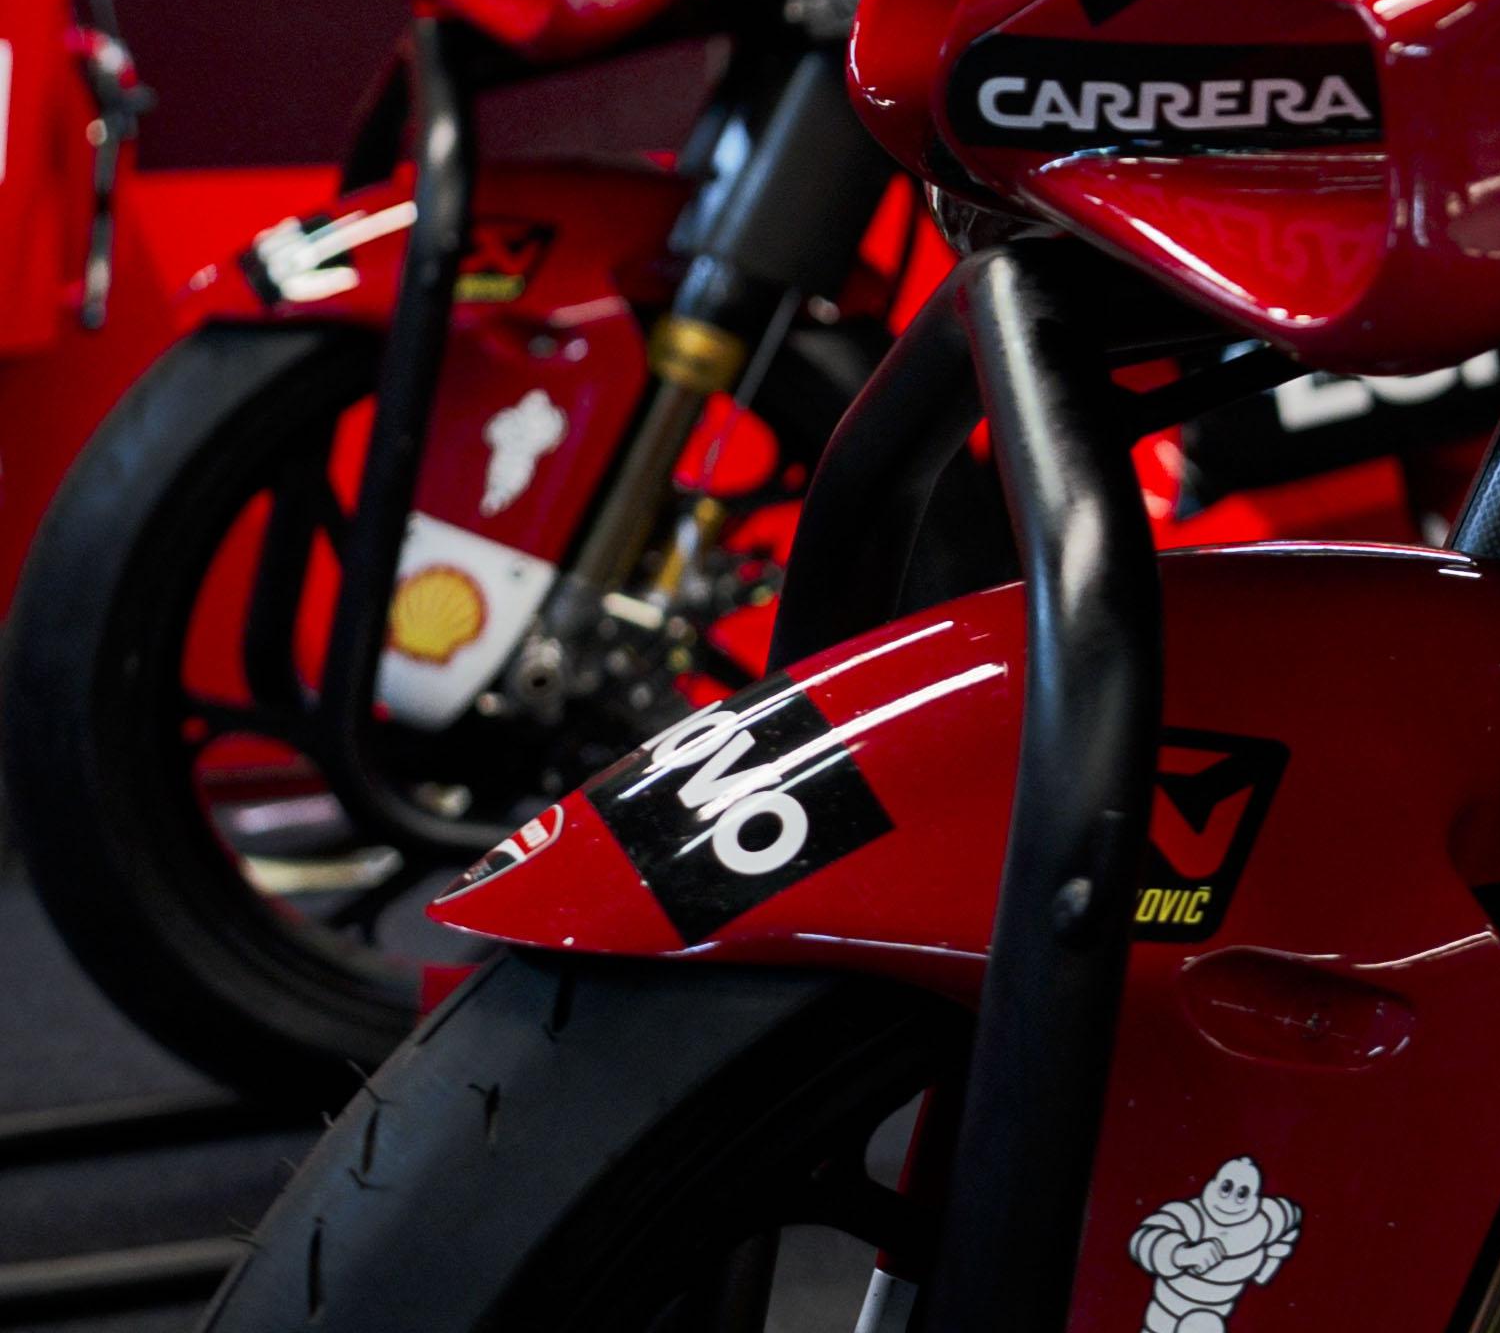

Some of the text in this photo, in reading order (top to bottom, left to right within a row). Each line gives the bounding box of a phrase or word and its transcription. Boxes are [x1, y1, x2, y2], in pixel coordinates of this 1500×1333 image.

[977, 75, 1372, 132] CARRERA
[642, 700, 808, 875] ovo
[1134, 886, 1210, 924] OVIČ
